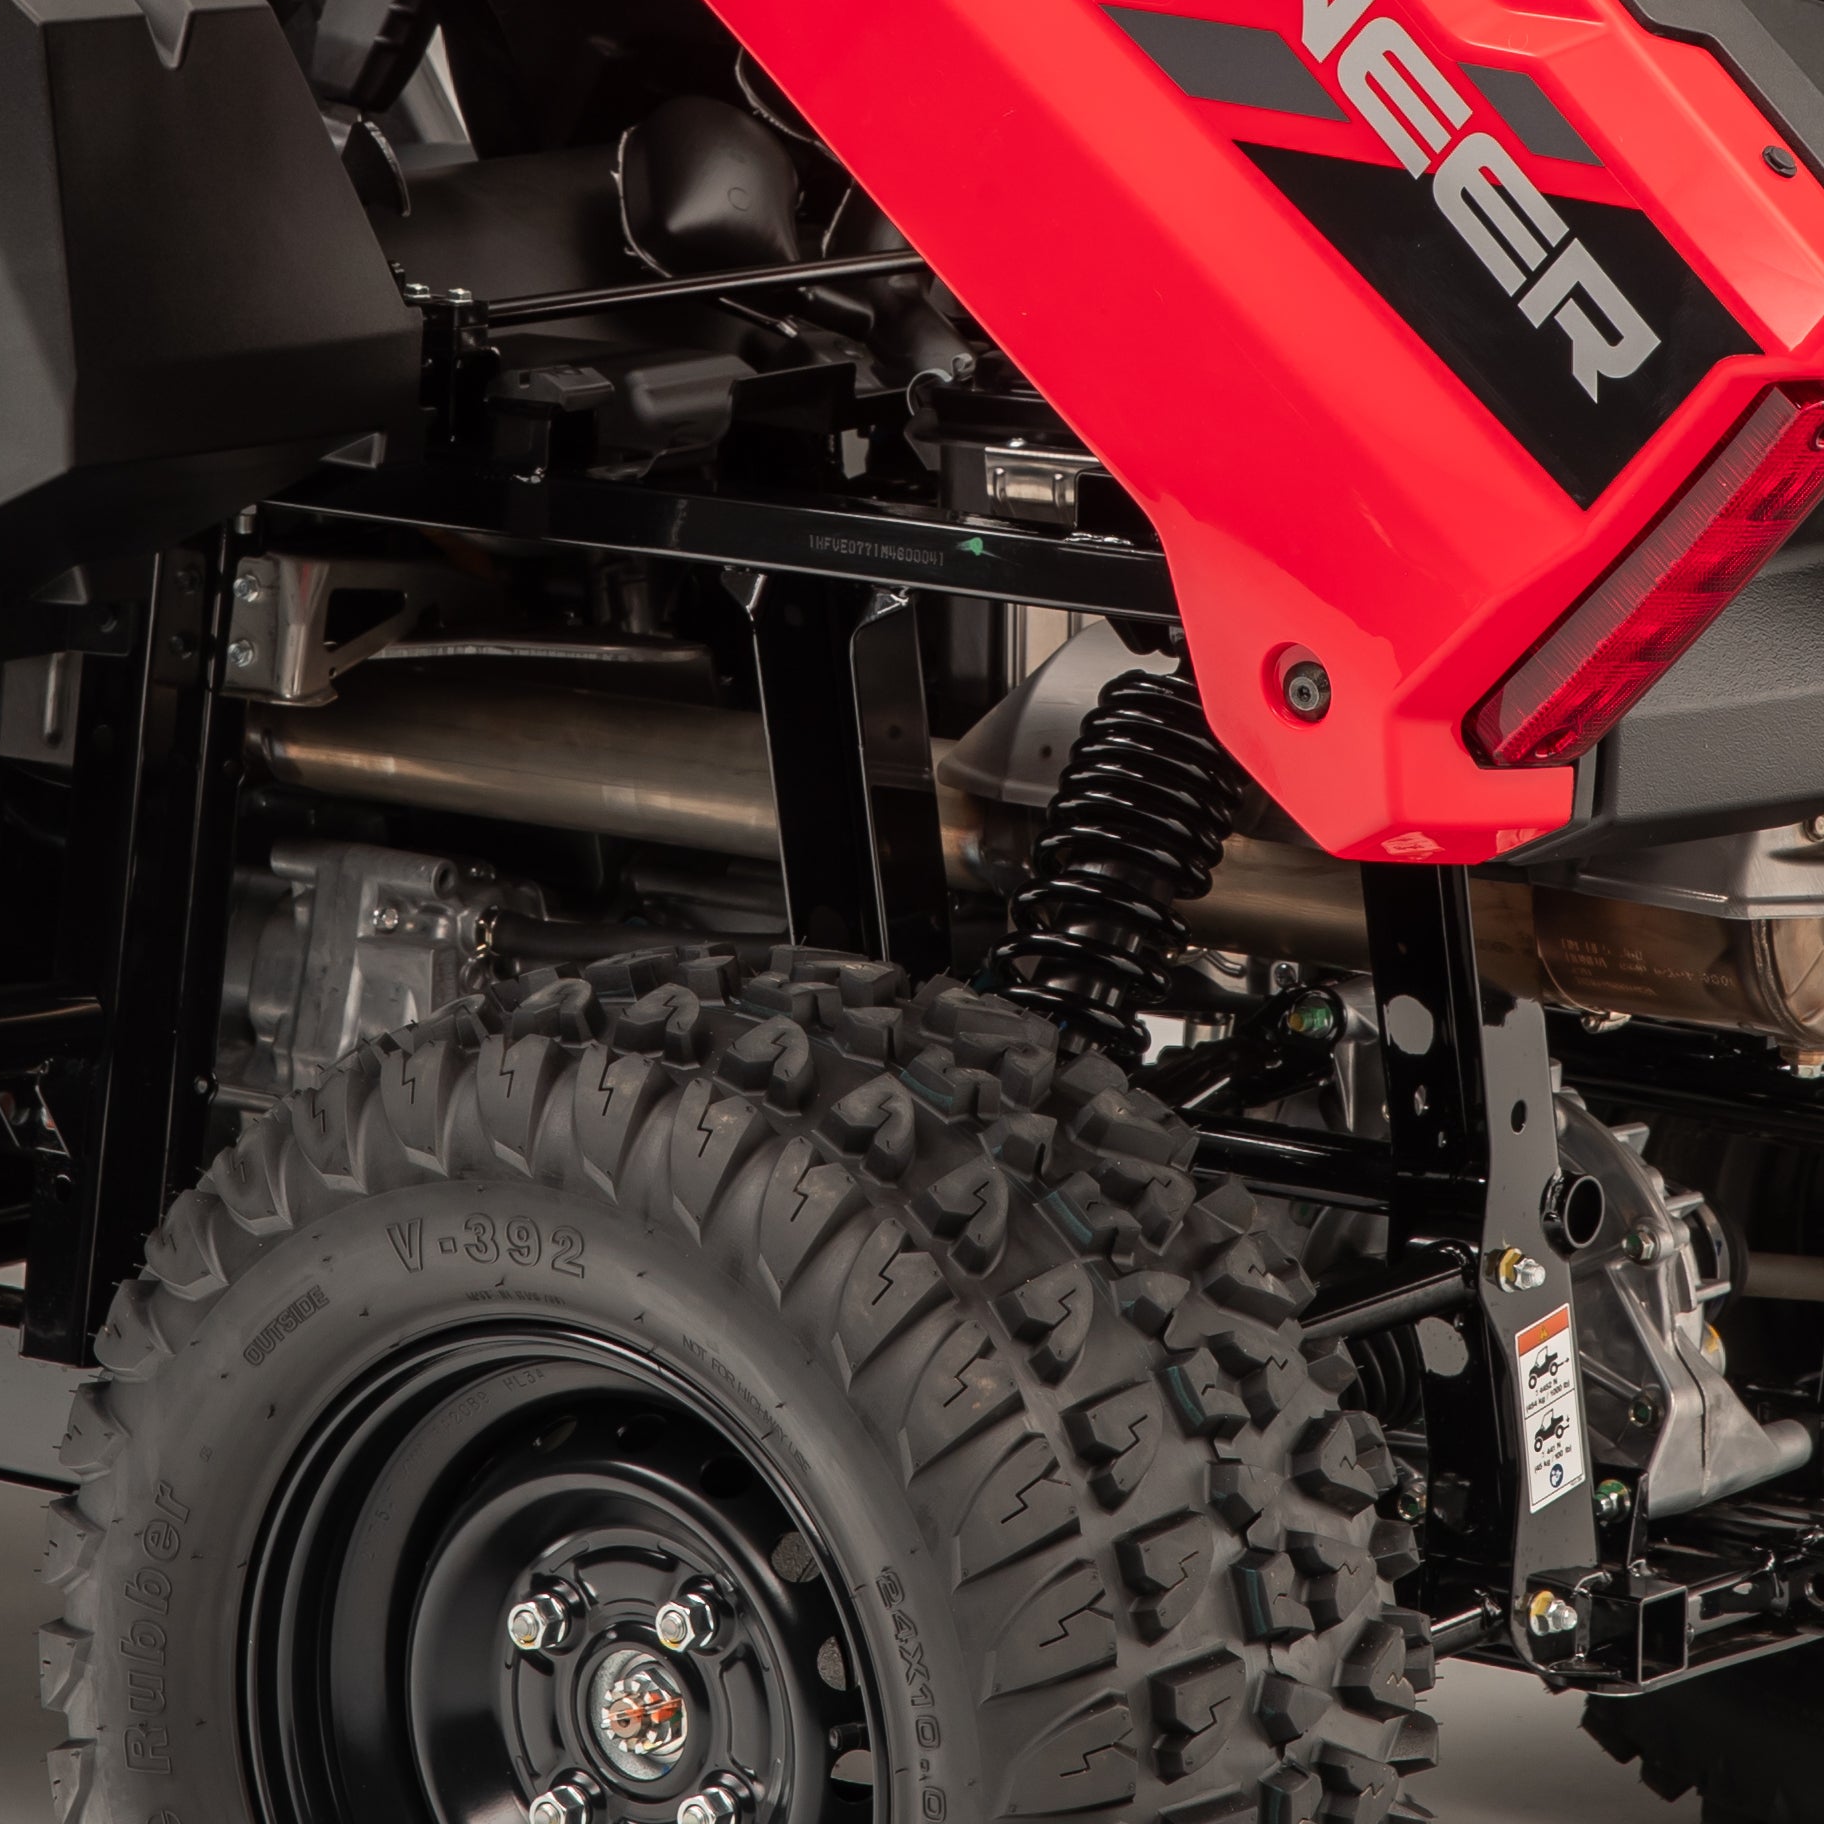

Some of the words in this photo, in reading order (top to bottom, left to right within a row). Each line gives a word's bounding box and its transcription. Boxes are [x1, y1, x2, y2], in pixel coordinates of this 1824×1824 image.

[385, 1213, 587, 1279] V-392
[242, 1285, 330, 1367] OUTSIDE
[683, 1336, 707, 1361] NOT
[711, 1358, 734, 1388] FOR
[737, 1382, 788, 1442] HIGHWAY
[788, 1442, 812, 1476] USE
[123, 1479, 192, 1775] Rubber
